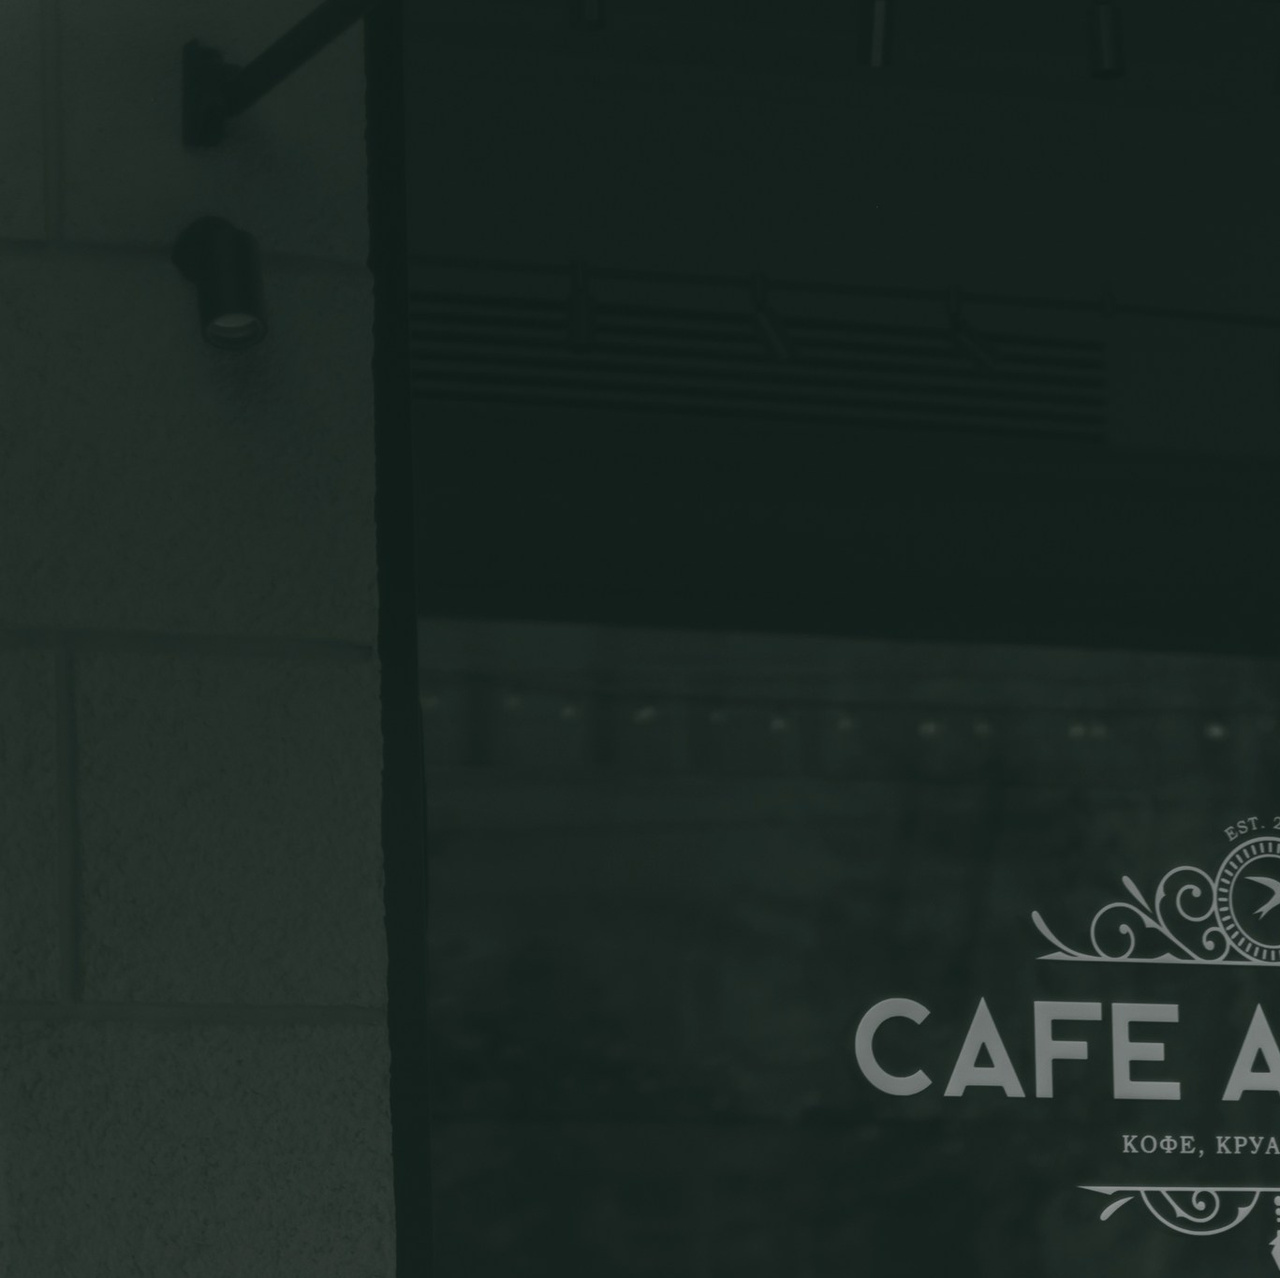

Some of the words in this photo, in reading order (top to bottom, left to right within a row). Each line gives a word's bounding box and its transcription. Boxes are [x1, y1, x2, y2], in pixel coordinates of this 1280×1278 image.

[1223, 815, 1266, 842] EST.
[854, 997, 1182, 1100] CAFE
[1122, 1134, 1204, 1158] КОФЕ,
